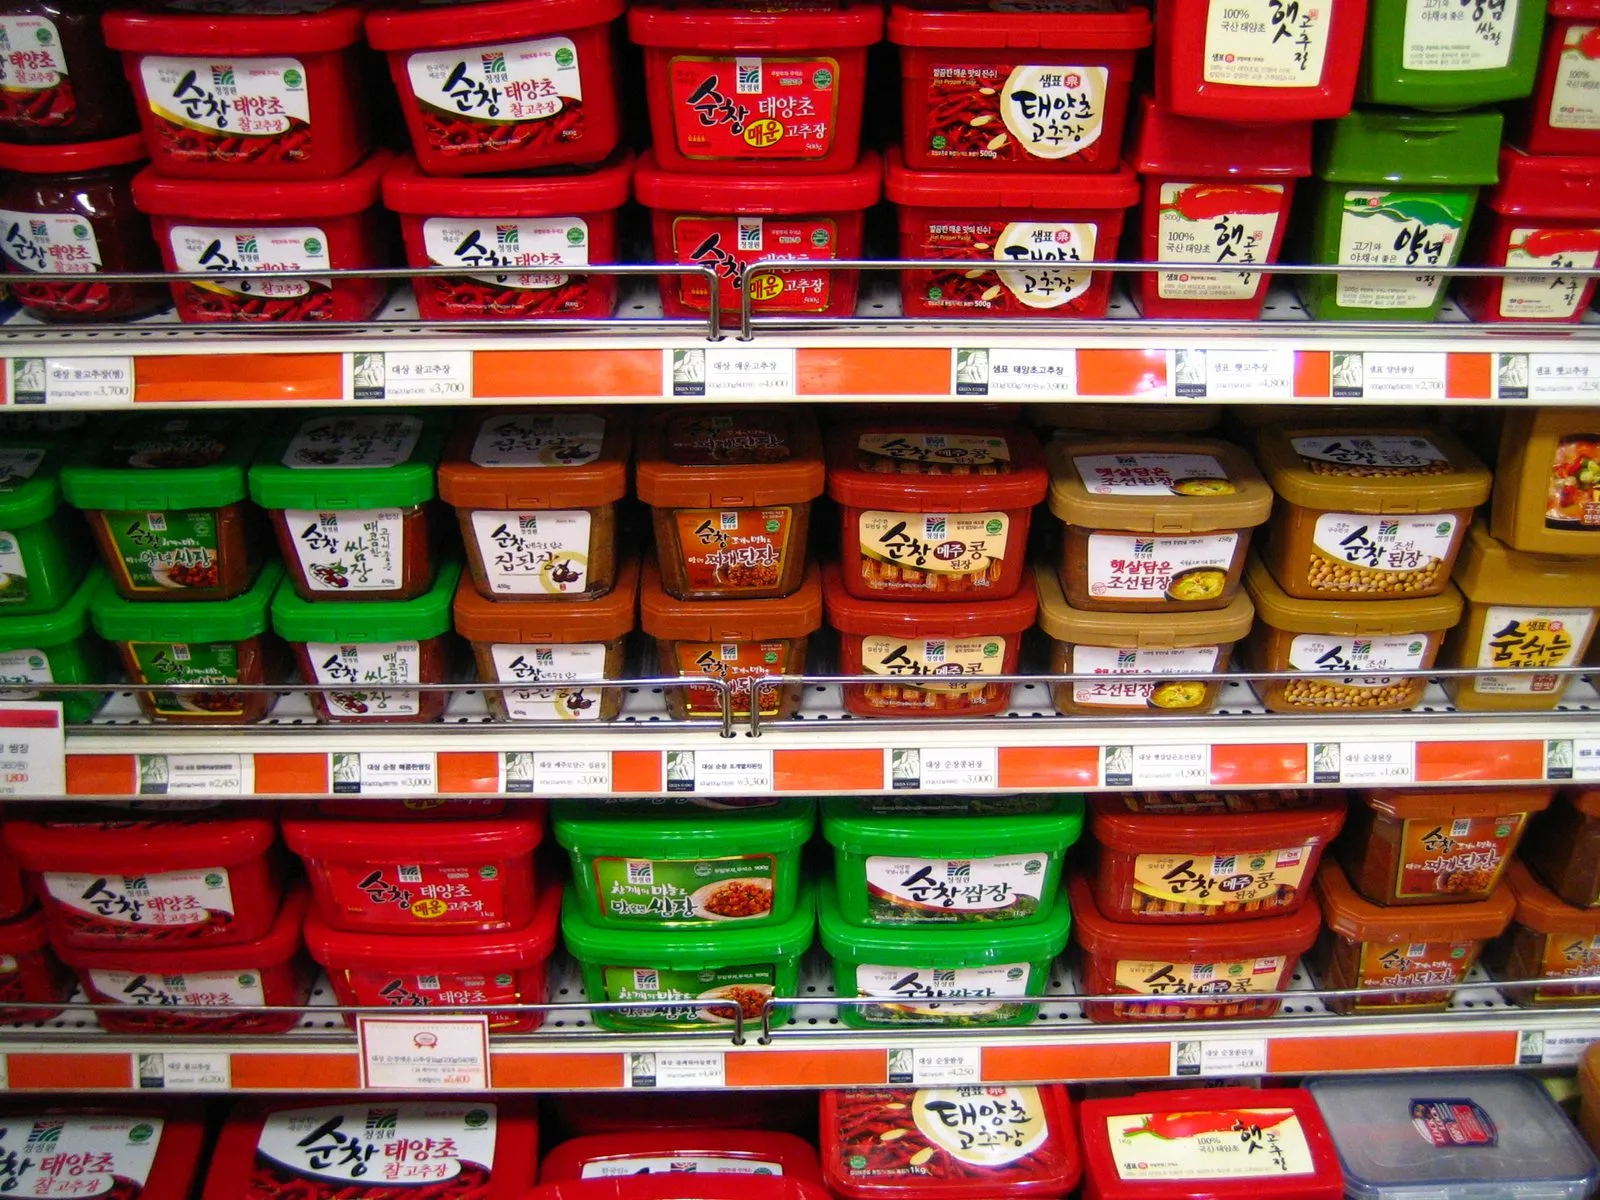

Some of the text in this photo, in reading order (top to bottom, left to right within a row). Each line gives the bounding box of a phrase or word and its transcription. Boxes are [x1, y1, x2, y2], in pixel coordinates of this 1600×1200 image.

[1223, 9, 1249, 19] 100%
[1221, 22, 1266, 34] 국산 태양초
[9, 51, 56, 69] 태양초
[442, 62, 559, 117] 순창 태양초
[1040, 75, 1062, 88] 샘표
[173, 70, 287, 129] 순창 태양초
[525, 101, 556, 115] 고추장
[687, 75, 816, 136] 순창 태양초
[1011, 90, 1094, 120] 태양초
[253, 118, 285, 132] 고추장
[748, 121, 827, 146] 매운 고추장
[1032, 119, 1085, 145] 고추장
[980, 150, 997, 158] 500g
[5, 222, 92, 268] 순창 태양초
[1031, 230, 1053, 242] 샘표
[1167, 231, 1194, 242] 100%
[1214, 216, 1243, 263] 햇
[1394, 224, 1445, 265] 양념
[1166, 243, 1211, 254] 국산 태양초
[1352, 241, 1381, 252] 고기와
[784, 279, 825, 294] 고추장
[1025, 272, 1075, 295] 고추장
[974, 300, 991, 308] 500g
[392, 364, 451, 375] 대상 찰고추장
[713, 361, 777, 370] 대상 매운고추장
[993, 364, 1064, 375] 샘표 태양초고추장
[1214, 363, 1230, 373] 샘표
[1536, 366, 1551, 375] 샘표
[53, 371, 70, 379] 대상
[1096, 467, 1170, 477] 햇살담은
[1102, 476, 1174, 487] 조선된장
[301, 523, 339, 554] 순창
[491, 523, 526, 552] 순창
[695, 519, 729, 545] 순창
[879, 521, 988, 566] 순창 메주 콩
[1339, 525, 1424, 568] 순창 된장
[1394, 541, 1414, 551] 조선
[345, 537, 374, 584] 쌈장
[494, 551, 560, 572] 집된장
[705, 545, 780, 567] 찌개된장
[950, 559, 972, 570] 된장
[1110, 559, 1173, 575] 햇살담은
[1107, 576, 1172, 591] 조선된장
[1526, 621, 1547, 631] 샘표
[1489, 620, 1572, 661] 숨쉬는
[323, 655, 360, 683] 순창
[509, 656, 542, 681] 순창
[696, 650, 729, 676] 순창
[1091, 683, 1154, 697] 조선된장
[945, 761, 982, 769] 순창콩된장
[1363, 754, 1392, 762] 순창된장
[1422, 827, 1457, 853] 순창
[901, 866, 1013, 907] 순창 쌈장
[1162, 859, 1276, 898] 순창 메주 콩
[358, 871, 473, 909] 순창 태양초
[1234, 890, 1257, 899] 된장
[82, 878, 205, 921] 순창 태양초
[414, 900, 484, 916] 매운 고추장
[647, 897, 697, 917] 쌈장
[1380, 949, 1411, 971] 순창
[439, 991, 488, 1003] 태양초
[1201, 982, 1229, 994] 메주
[185, 993, 233, 1005] 태양초
[924, 1100, 1032, 1127] 태양초
[364, 1130, 396, 1140] 청정원
[957, 1126, 1025, 1151] 고추장
[1231, 1118, 1264, 1155] 햇
[296, 1116, 459, 1177] 순창 태양초
[40, 1153, 115, 1177] 태양초
[383, 1163, 449, 1181] 찰 고추장
[910, 1166, 926, 1175] 1kg
[34, 1177, 101, 1195] 찰 고추장
